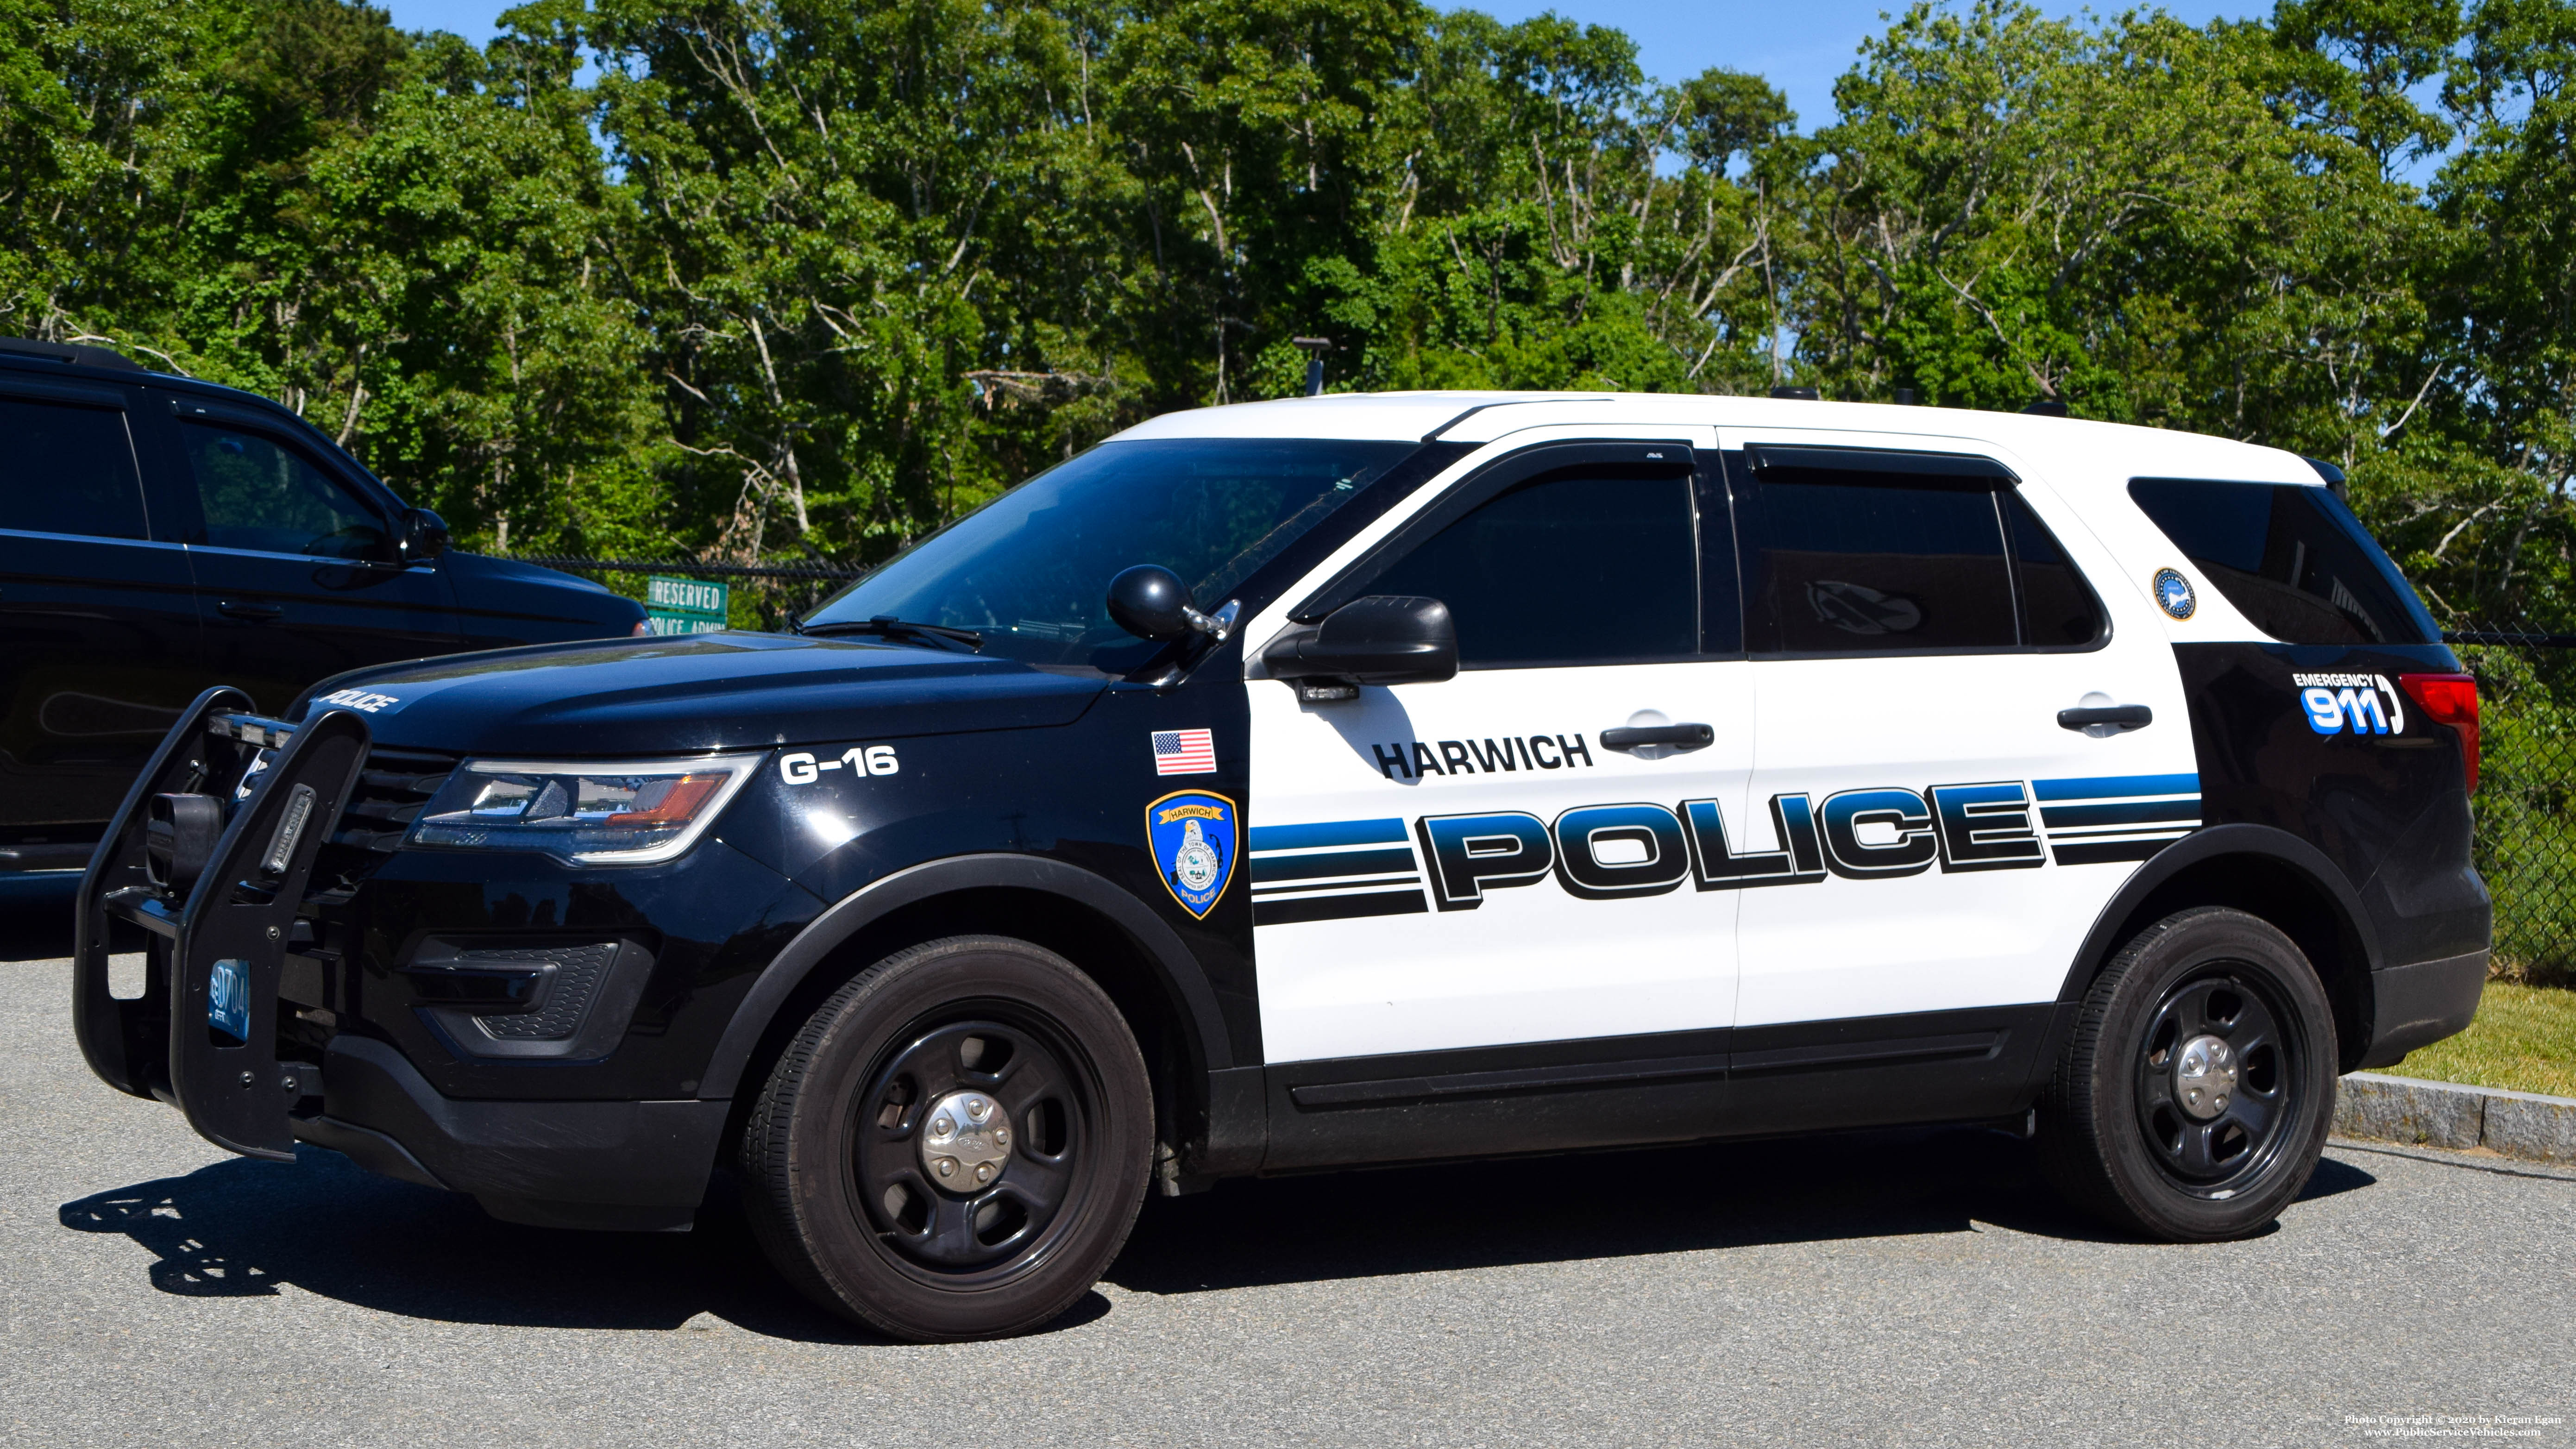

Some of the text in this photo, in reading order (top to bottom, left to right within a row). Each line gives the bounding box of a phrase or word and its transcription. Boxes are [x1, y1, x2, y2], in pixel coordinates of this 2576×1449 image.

[655, 581, 719, 610] RESERVED
[2293, 673, 2375, 687] EMERGENCY
[318, 690, 399, 713] POLICE
[2300, 687, 2388, 734] 911
[780, 746, 899, 785] G-16
[1372, 734, 1594, 778] HARWICH
[1171, 808, 1211, 819] HARWICH
[1418, 781, 2047, 912] POLICE
[1181, 886, 1216, 904] POLICE
